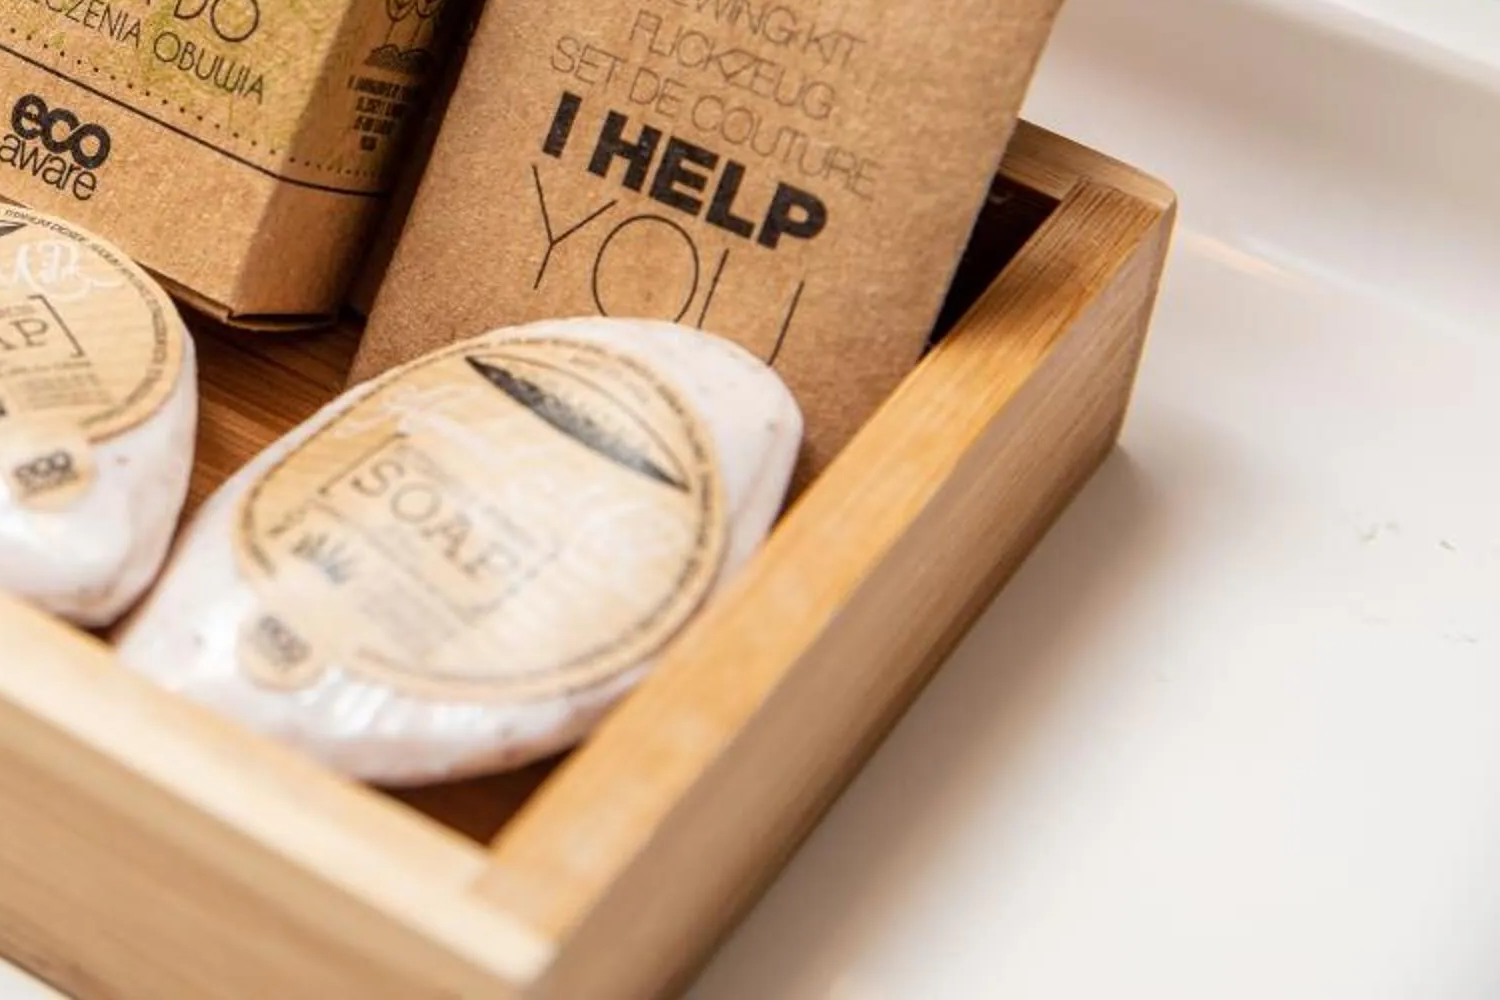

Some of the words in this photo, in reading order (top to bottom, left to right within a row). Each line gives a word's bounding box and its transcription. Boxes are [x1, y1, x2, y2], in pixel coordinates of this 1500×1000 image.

[153, 31, 265, 105] OBUWIA
[550, 35, 626, 94] SET
[628, 66, 688, 118] DE
[691, 94, 885, 201] COUTURE
[628, 8, 836, 121] FLICKZEUG
[10, 93, 111, 169] eco
[542, 90, 583, 159] I
[587, 109, 828, 250] HELP
[532, 164, 805, 367] YOU
[350, 457, 522, 580] SOAP
